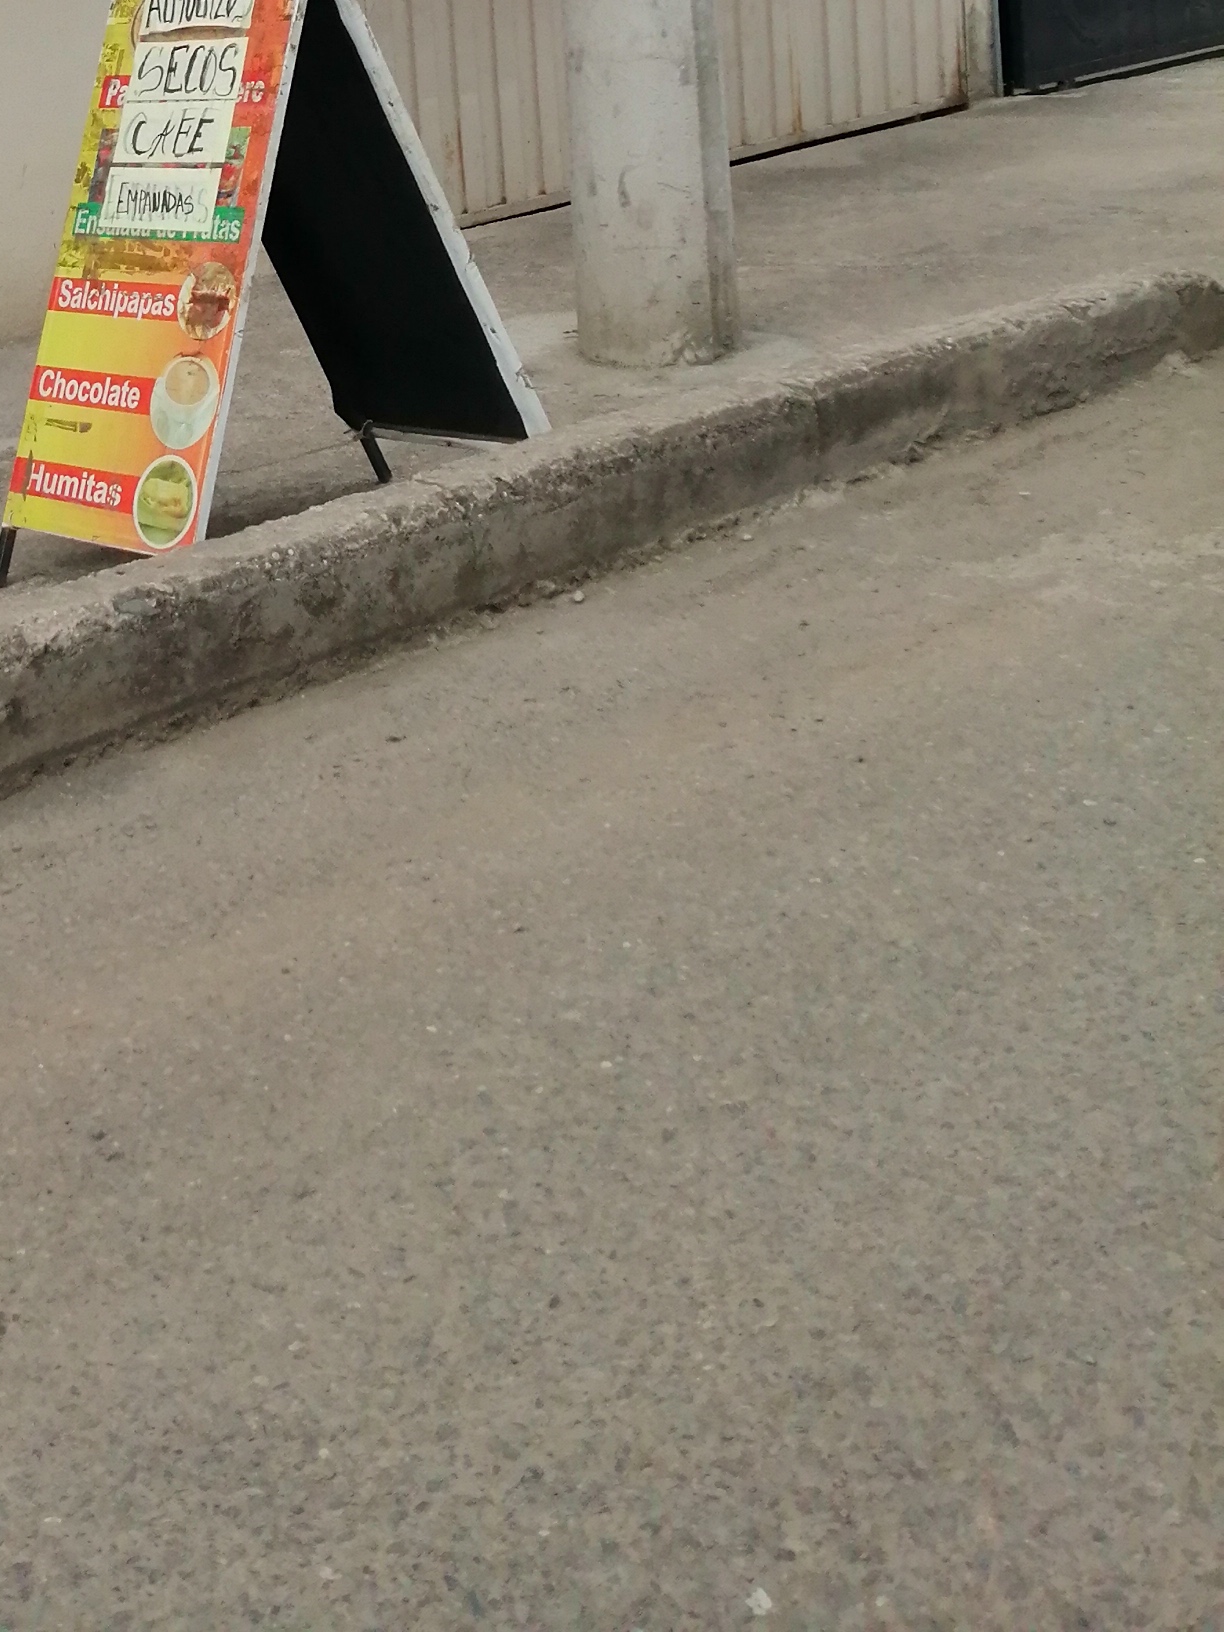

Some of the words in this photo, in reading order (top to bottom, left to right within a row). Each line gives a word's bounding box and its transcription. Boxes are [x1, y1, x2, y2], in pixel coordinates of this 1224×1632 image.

[135, 42, 238, 96] SECOS
[124, 108, 216, 159] CAFE
[116, 181, 194, 215] EMPANADAS
[58, 279, 176, 321] Salchipapas
[38, 369, 141, 410] Chocolate
[27, 462, 123, 507] Humitas
